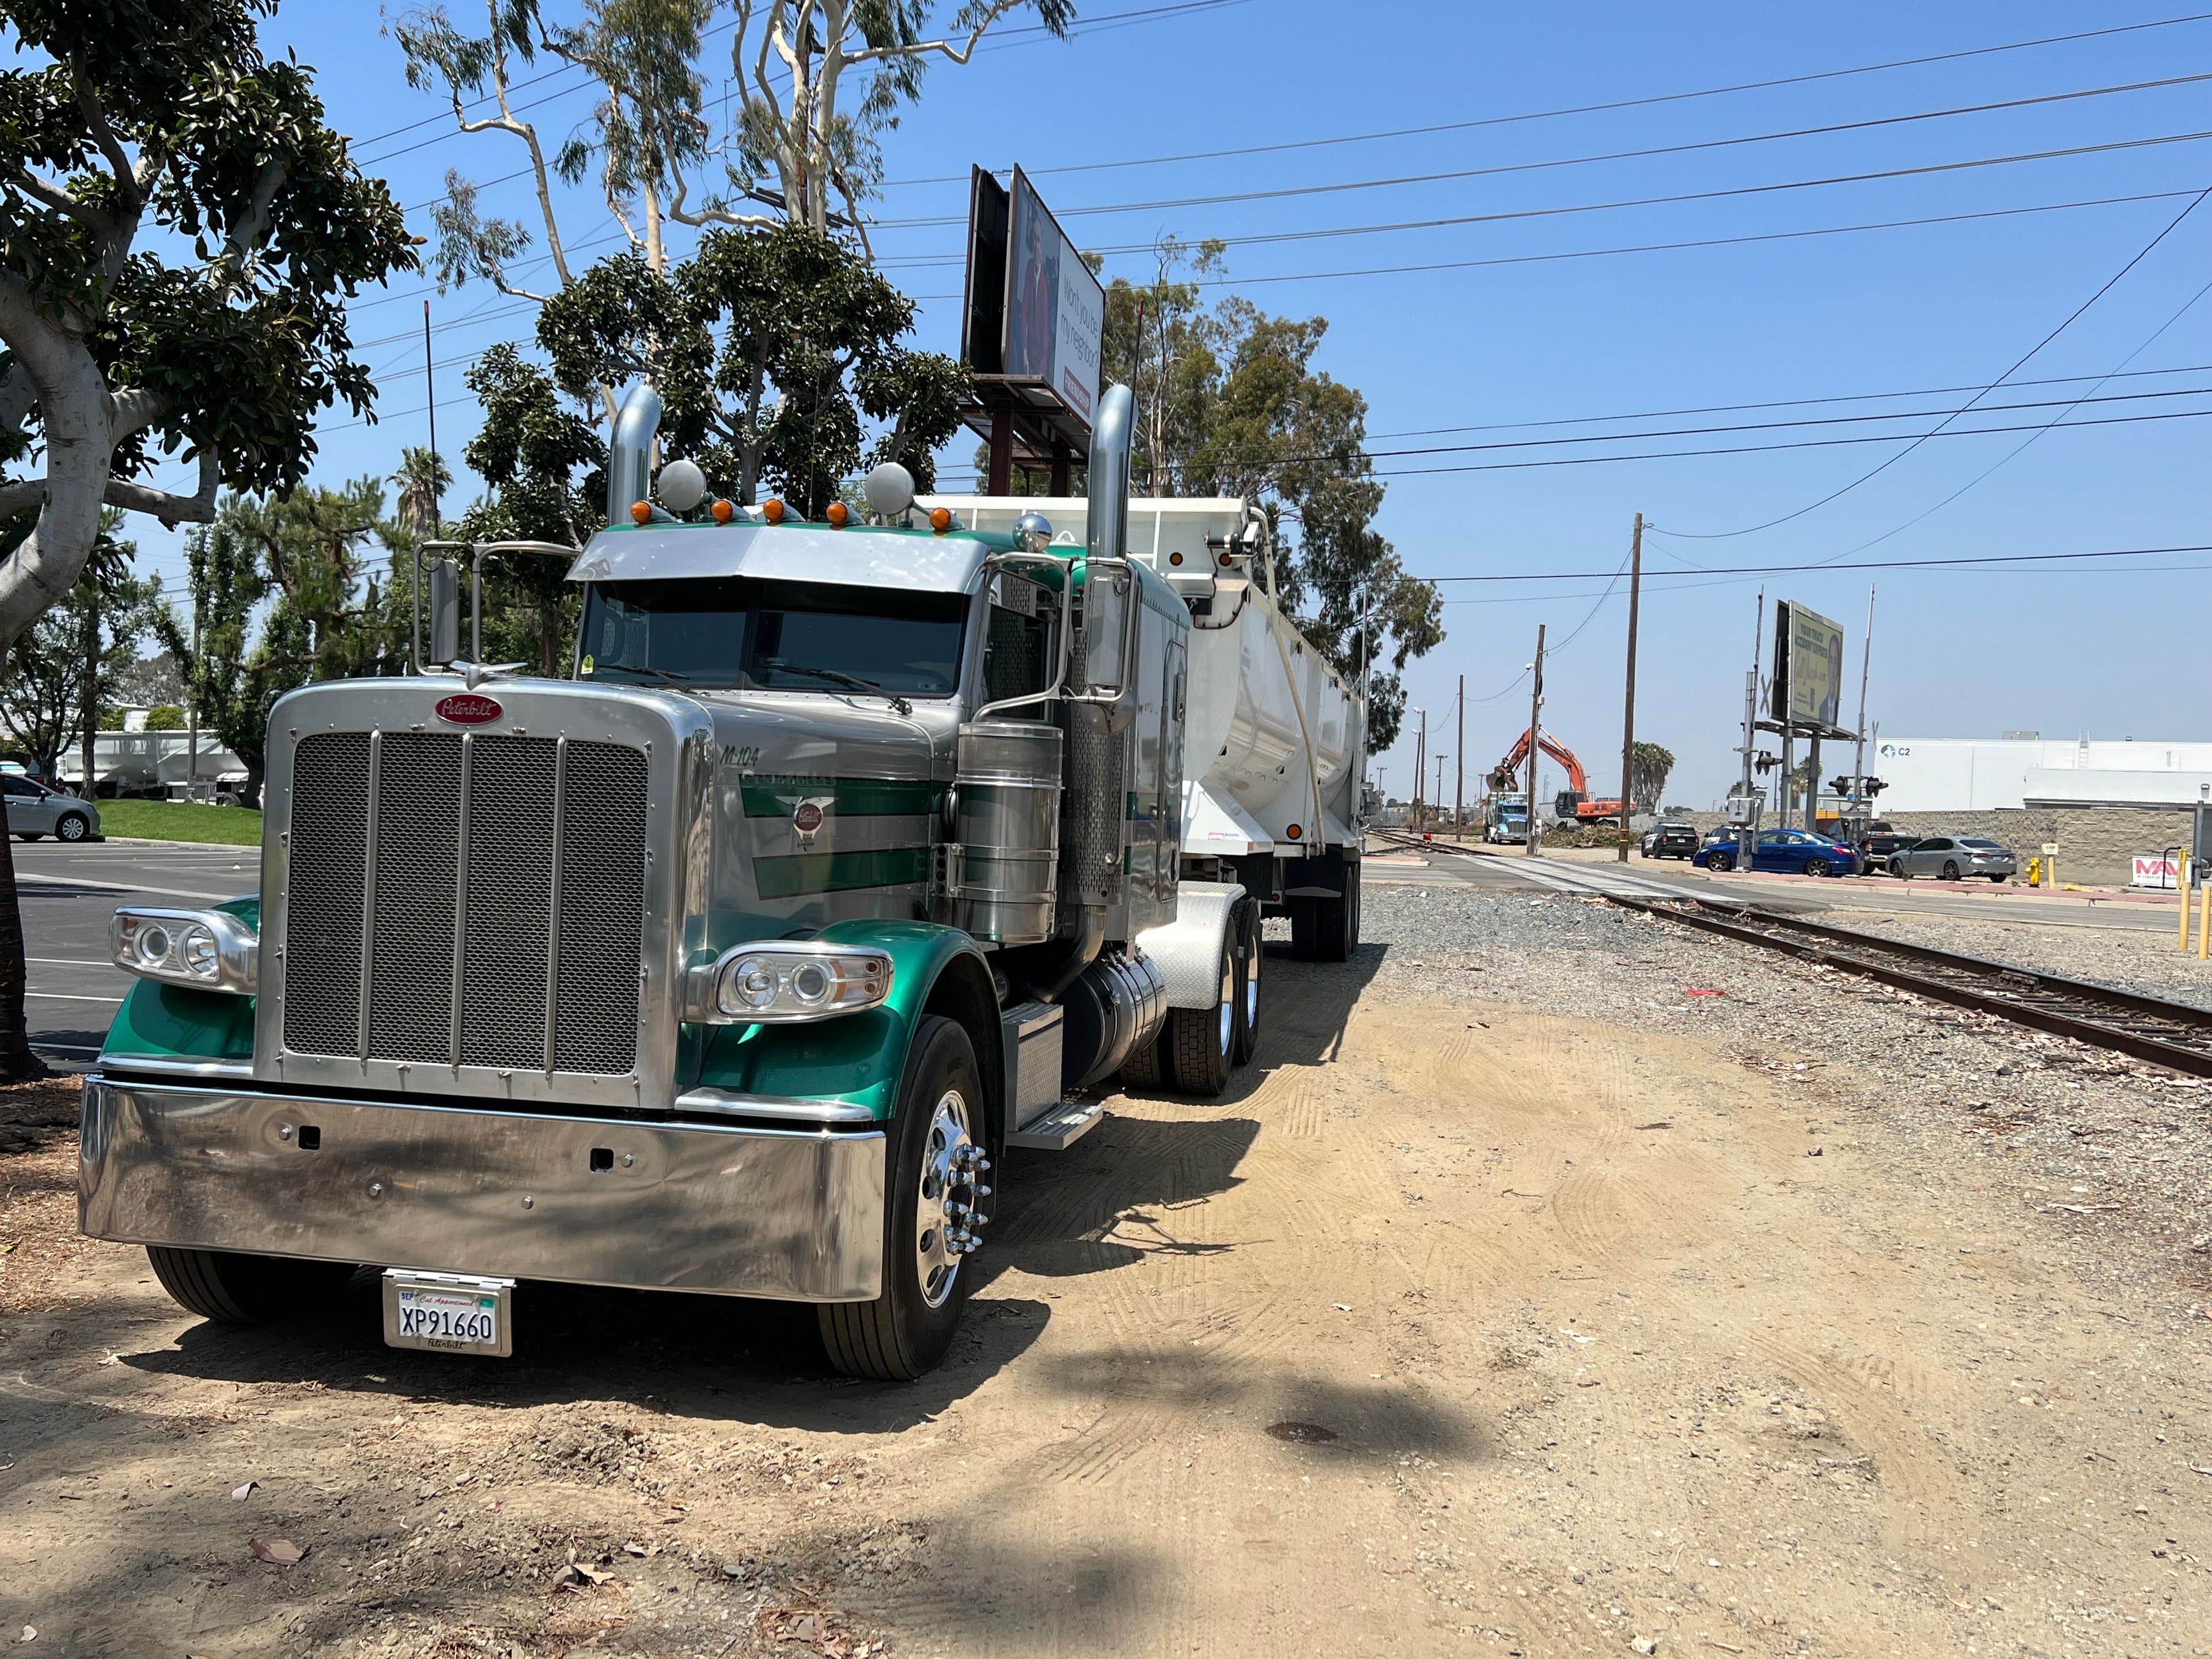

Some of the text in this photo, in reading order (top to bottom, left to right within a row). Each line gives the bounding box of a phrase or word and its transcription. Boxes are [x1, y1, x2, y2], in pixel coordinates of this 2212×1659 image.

[1080, 301, 1090, 329] you
[1090, 309, 1098, 339] be
[1060, 313, 1071, 344] my
[1800, 622, 1811, 638] YOUR
[441, 698, 497, 716] Peterbilt
[1899, 748, 1910, 756] C2
[401, 1292, 413, 1300] SEP
[434, 1297, 475, 1306] Apportioned
[402, 1308, 491, 1339] XP91660
[428, 1339, 467, 1350] Peterbilt
